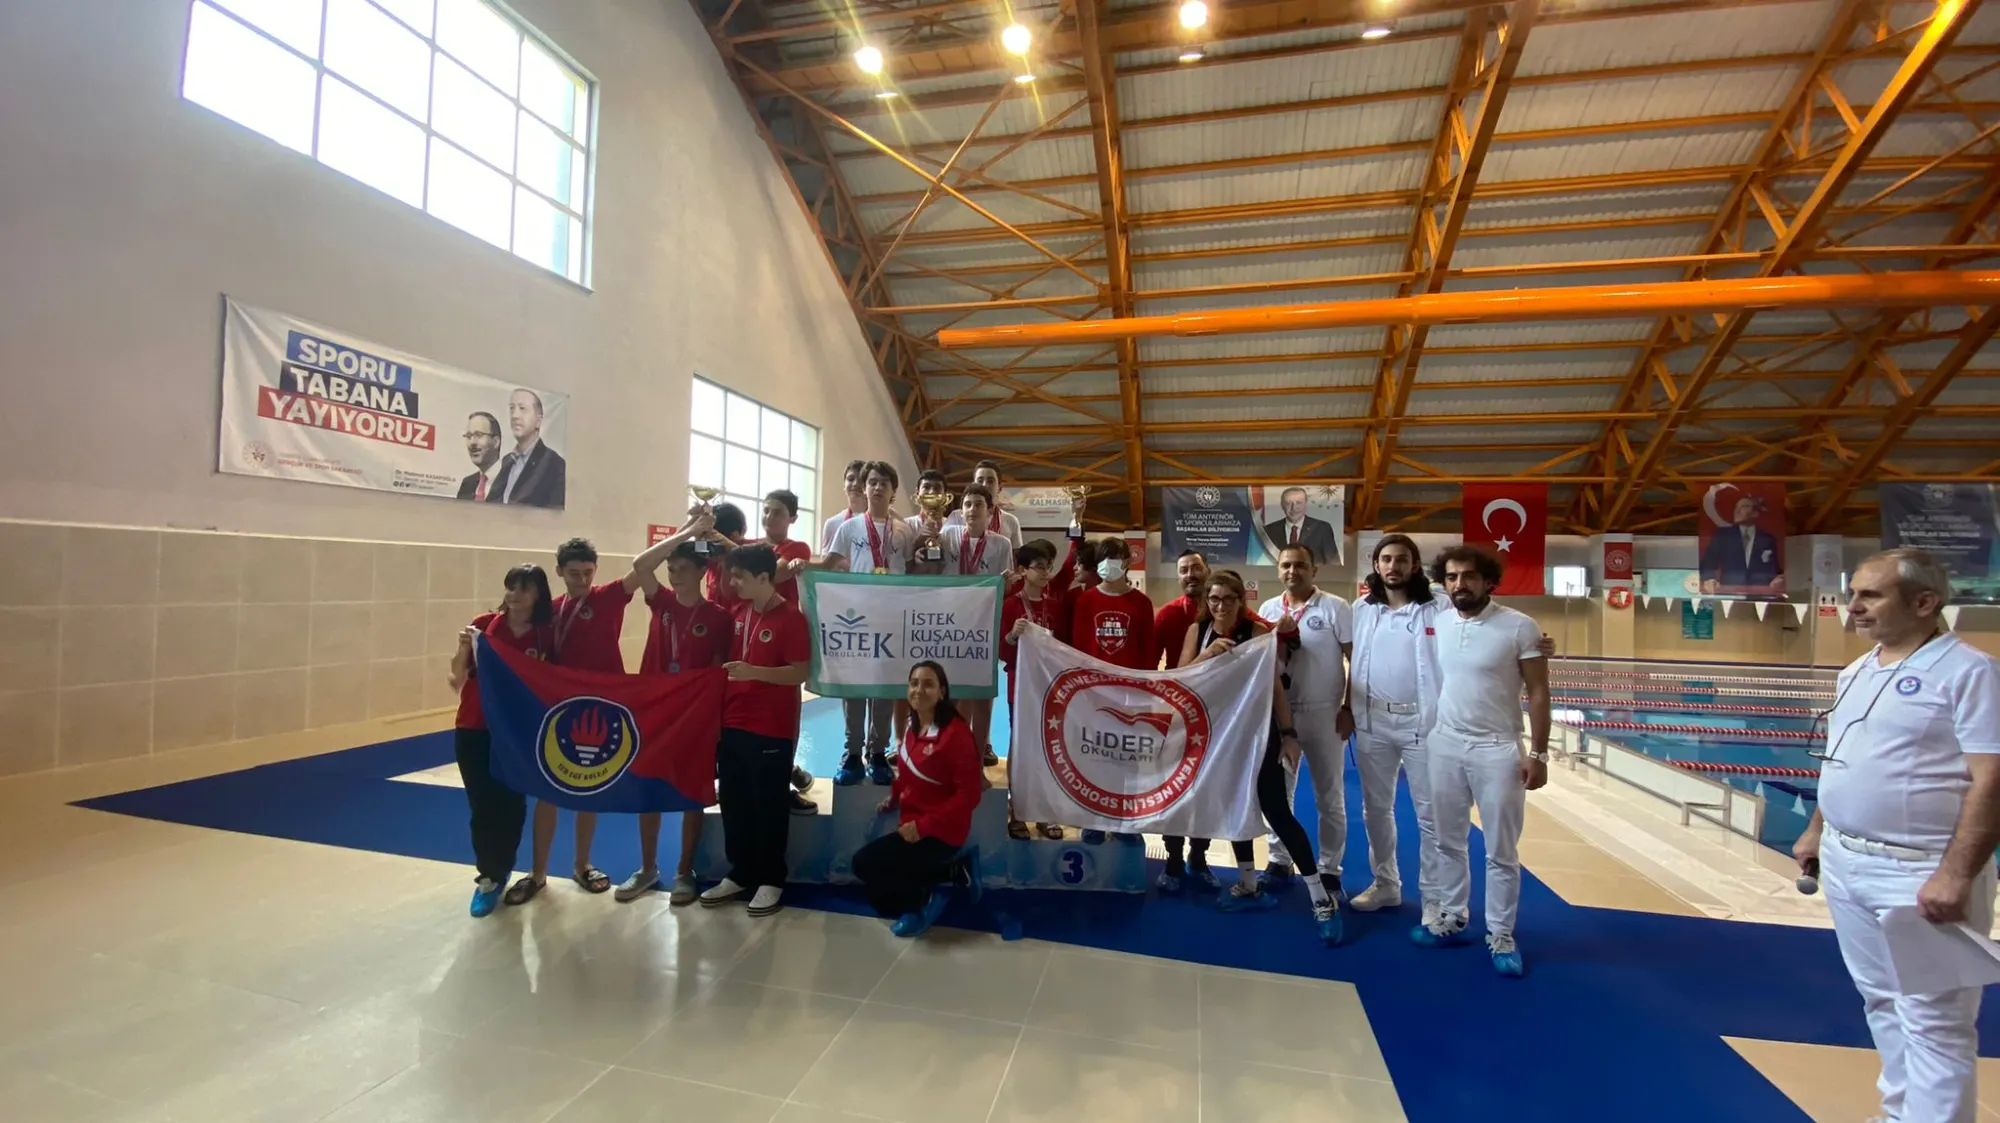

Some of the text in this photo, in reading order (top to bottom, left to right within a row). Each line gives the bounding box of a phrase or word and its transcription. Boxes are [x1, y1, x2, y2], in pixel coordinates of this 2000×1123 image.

[298, 338, 397, 387] SPORU
[290, 366, 409, 416] TABANA
[267, 391, 429, 448] YAYIYORUZ
[911, 609, 955, 626] İSTEK
[820, 623, 896, 659] İSTEK
[909, 646, 989, 660] OKULLARI
[911, 629, 989, 645] KUŞADASI
[1051, 739, 1197, 813] YENİ NESLİN SPORCULARI
[1062, 851, 1084, 884] 3
